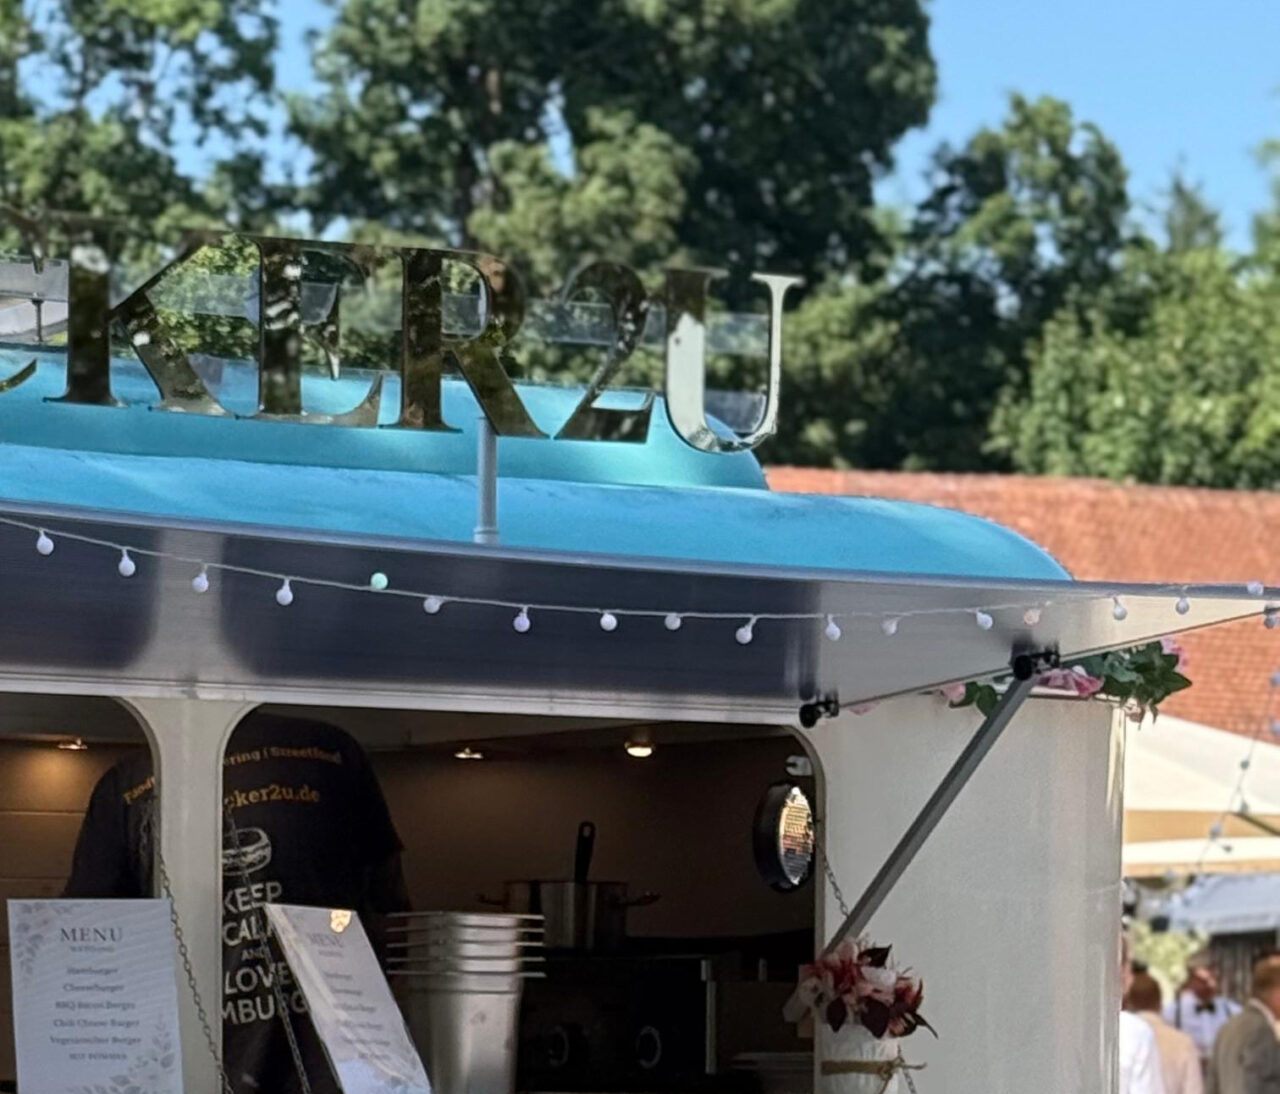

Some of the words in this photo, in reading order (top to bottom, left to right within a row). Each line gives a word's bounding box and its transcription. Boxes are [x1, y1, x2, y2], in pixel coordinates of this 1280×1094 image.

[222, 881, 282, 914] KEEP
[60, 927, 123, 942] MENU
[225, 962, 291, 995] LOVE
